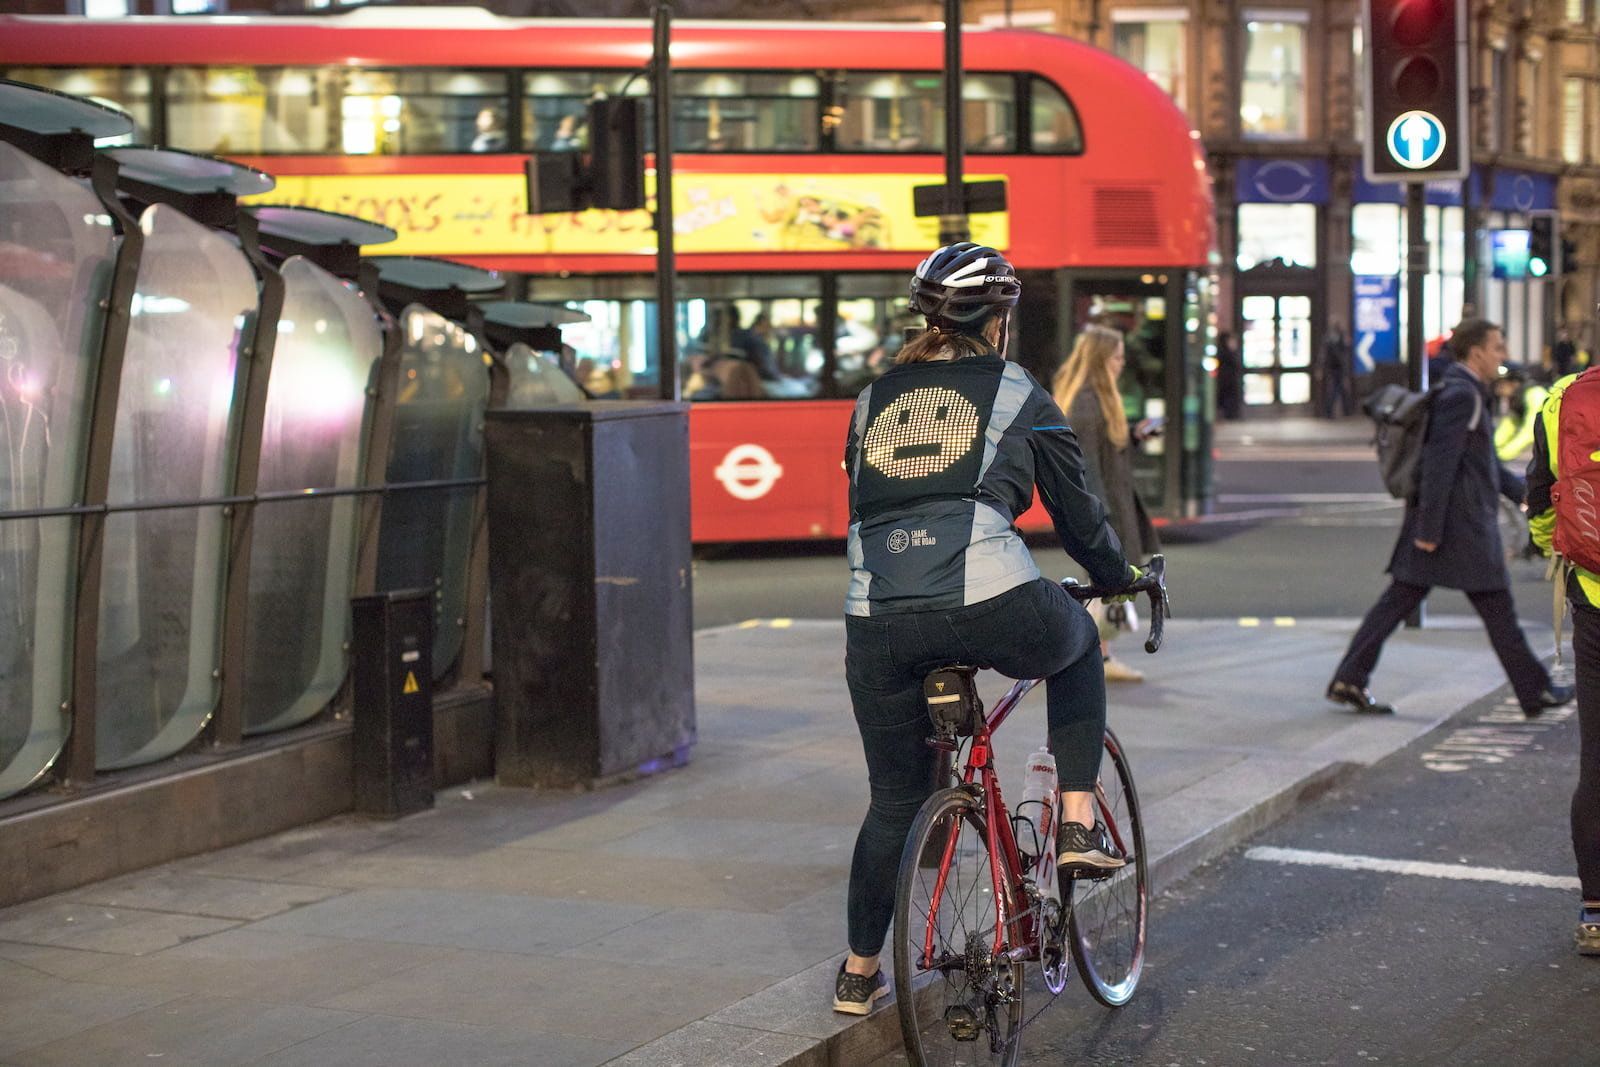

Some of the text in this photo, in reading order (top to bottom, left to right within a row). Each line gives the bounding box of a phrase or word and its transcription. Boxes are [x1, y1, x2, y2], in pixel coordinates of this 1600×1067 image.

[911, 529, 928, 538] SHARE
[911, 536, 936, 547] THE ROAD
